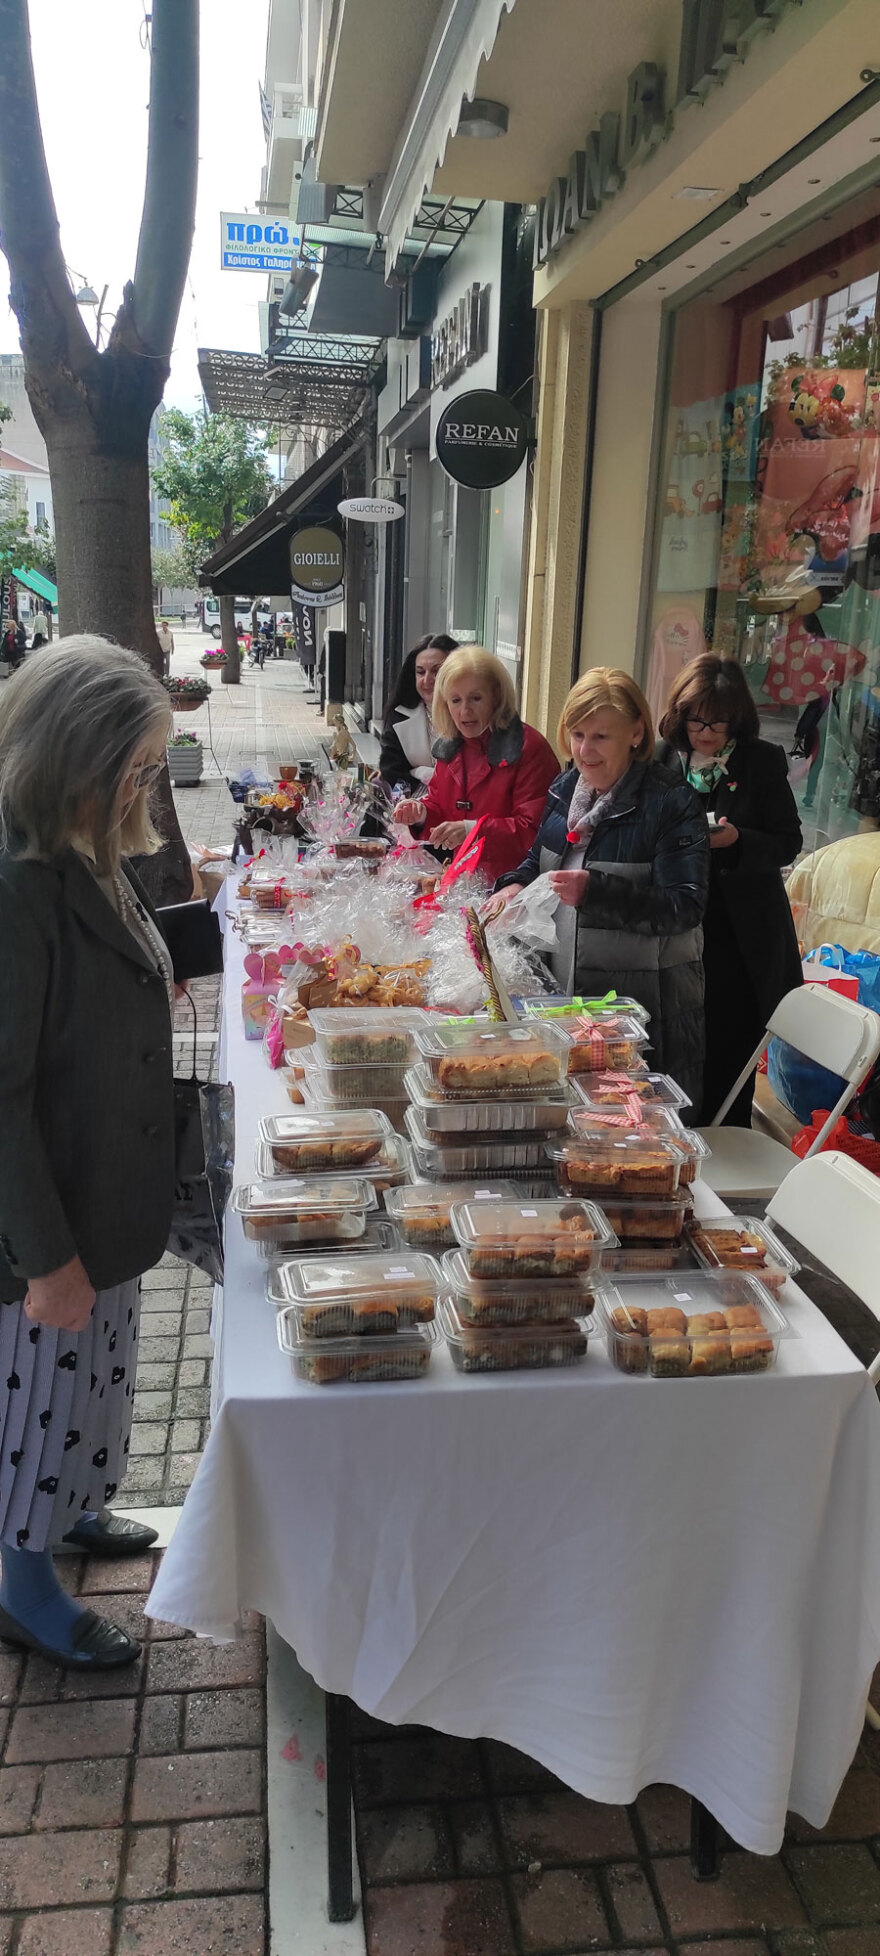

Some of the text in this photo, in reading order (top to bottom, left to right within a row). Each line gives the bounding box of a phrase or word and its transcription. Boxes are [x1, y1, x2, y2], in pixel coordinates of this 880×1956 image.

[227, 221, 299, 246] πρώ
[225, 244, 272, 253] ΦΙΛΟΛΟΓΙΚΟ
[227, 254, 261, 267] Χρίστος
[445, 423, 520, 442] REFAN
[350, 503, 387, 514] swatch
[293, 552, 340, 566] GIOIELLI
